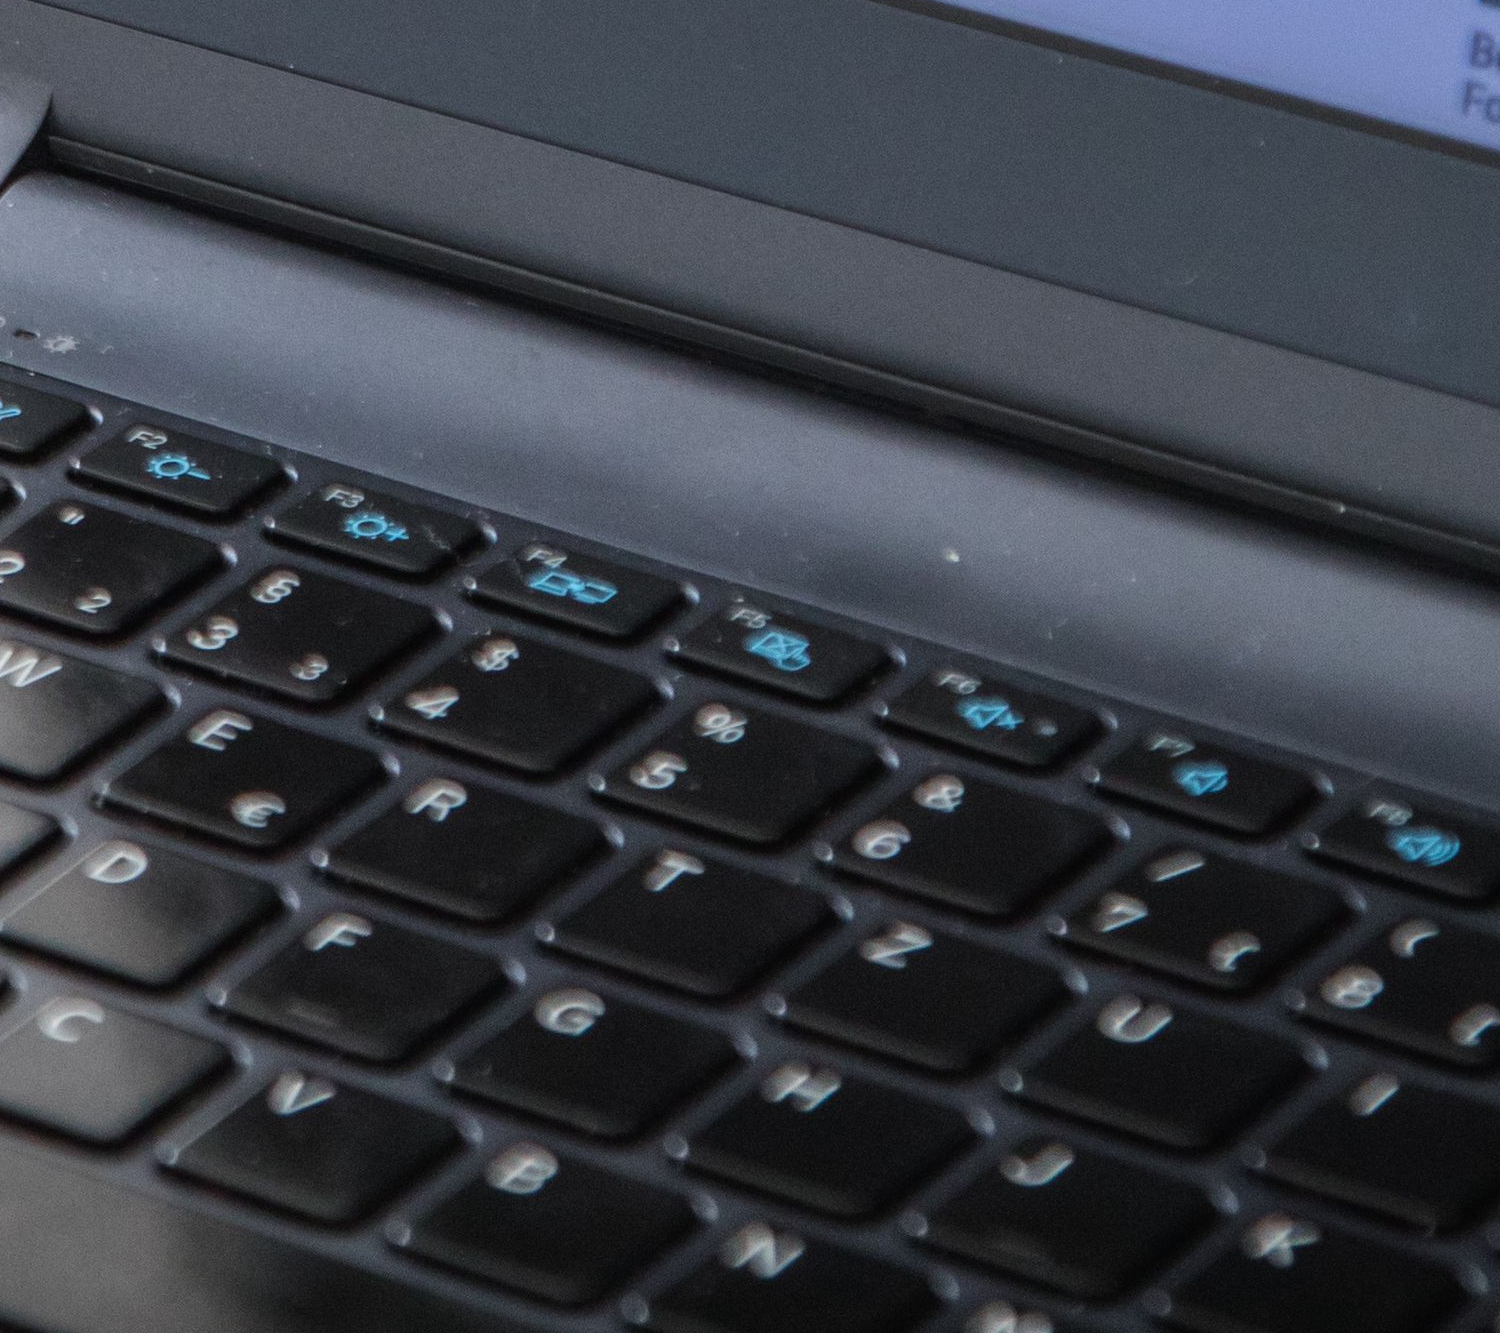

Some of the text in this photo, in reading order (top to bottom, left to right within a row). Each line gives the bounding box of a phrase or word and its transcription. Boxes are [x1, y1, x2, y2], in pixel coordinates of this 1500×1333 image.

[131, 428, 168, 451] F2
[326, 485, 364, 508] F3
[526, 544, 567, 571] F4
[187, 615, 239, 651] 3
[405, 686, 459, 720] 4
[697, 702, 748, 744] %
[188, 709, 253, 752] E
[629, 751, 687, 791] 5
[405, 777, 467, 822] R
[853, 819, 912, 860] 6
[85, 840, 149, 884] D
[644, 848, 704, 893] T
[304, 912, 373, 951] F
[860, 922, 934, 968] Z
[36, 998, 105, 1043] C
[535, 988, 606, 1036] G
[1099, 995, 1174, 1043] U
[267, 1071, 336, 1115] V
[759, 1062, 842, 1112] H
[486, 1141, 559, 1196] B
[722, 1220, 806, 1280] N
